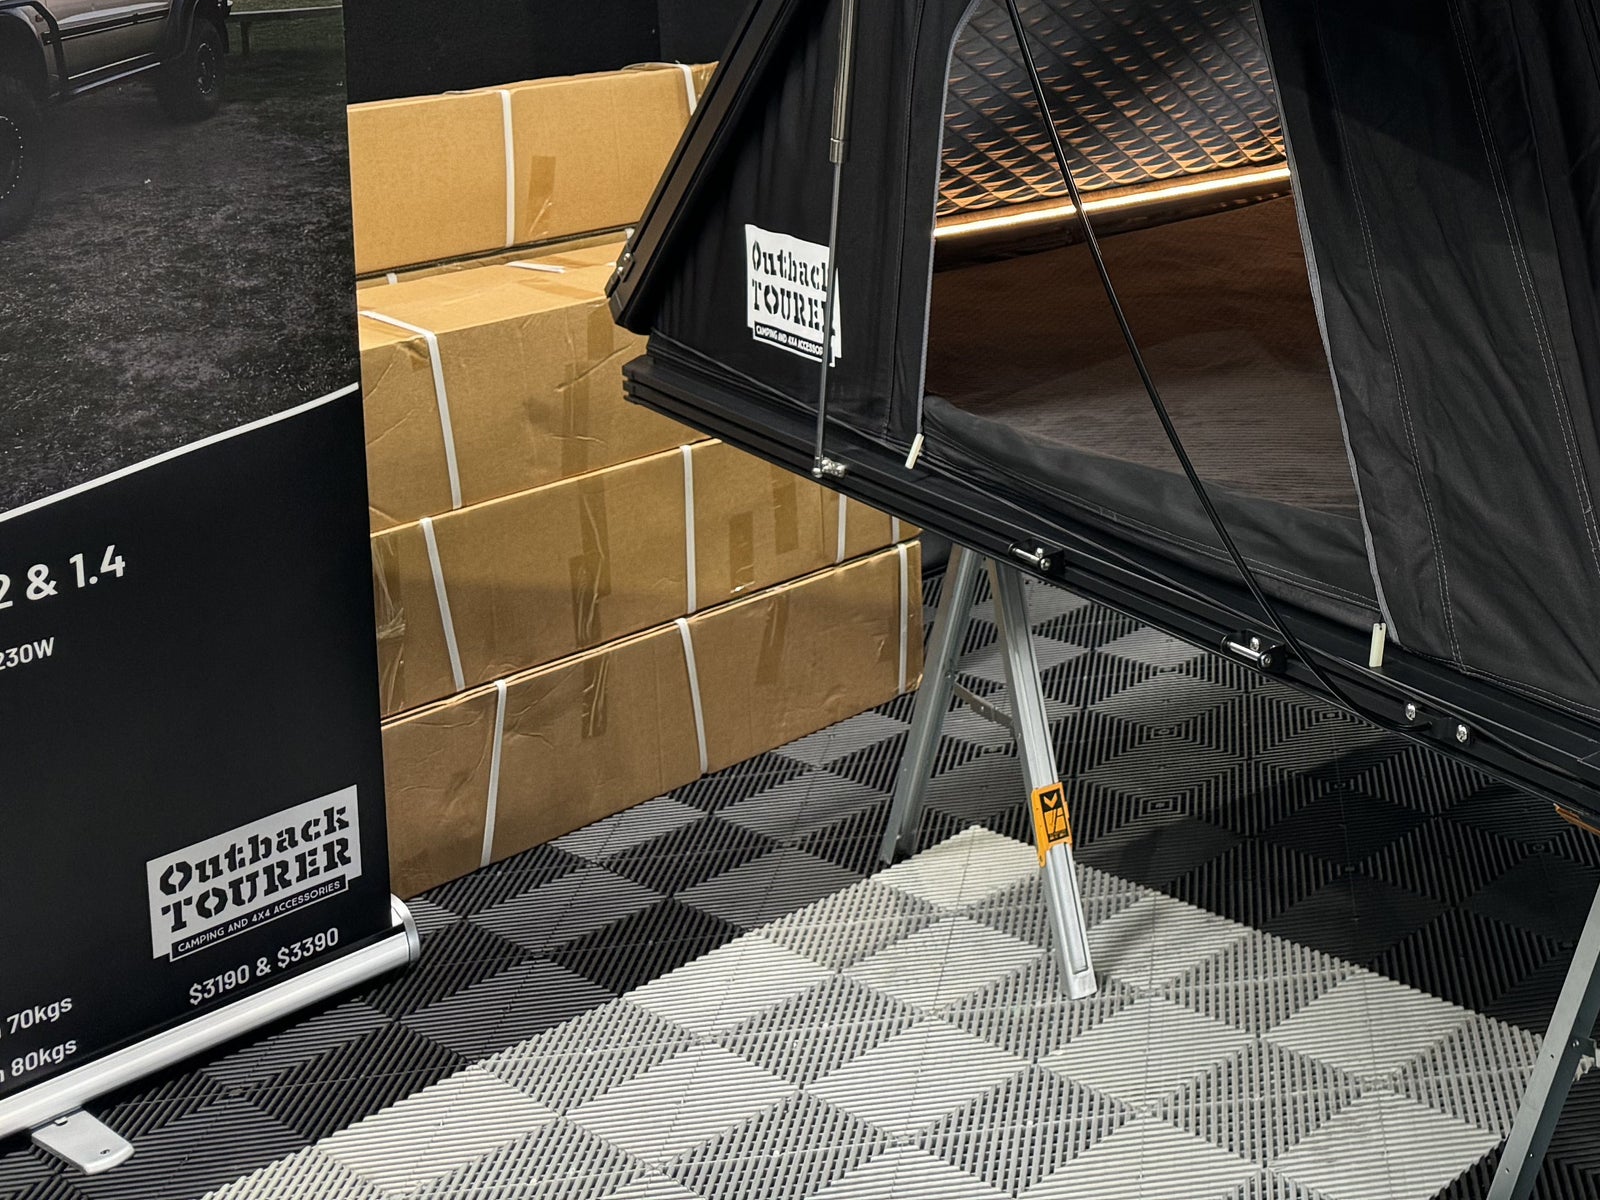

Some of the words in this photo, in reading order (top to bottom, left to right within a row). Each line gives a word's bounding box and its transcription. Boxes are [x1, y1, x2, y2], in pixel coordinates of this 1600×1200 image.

[26, 563, 58, 600] &
[69, 545, 126, 588] 1.4
[159, 806, 349, 896] Outback
[161, 837, 351, 933] TOURER
[178, 927, 225, 952] CAMPING
[228, 918, 248, 933] AND
[252, 909, 271, 922] 4X4
[274, 880, 341, 913] ACCESSORIES
[189, 964, 250, 1005] $3190
[256, 956, 272, 977] &
[277, 927, 339, 969] $3390
[7, 997, 73, 1034] 70kgs
[11, 1039, 77, 1077] 80kgs
